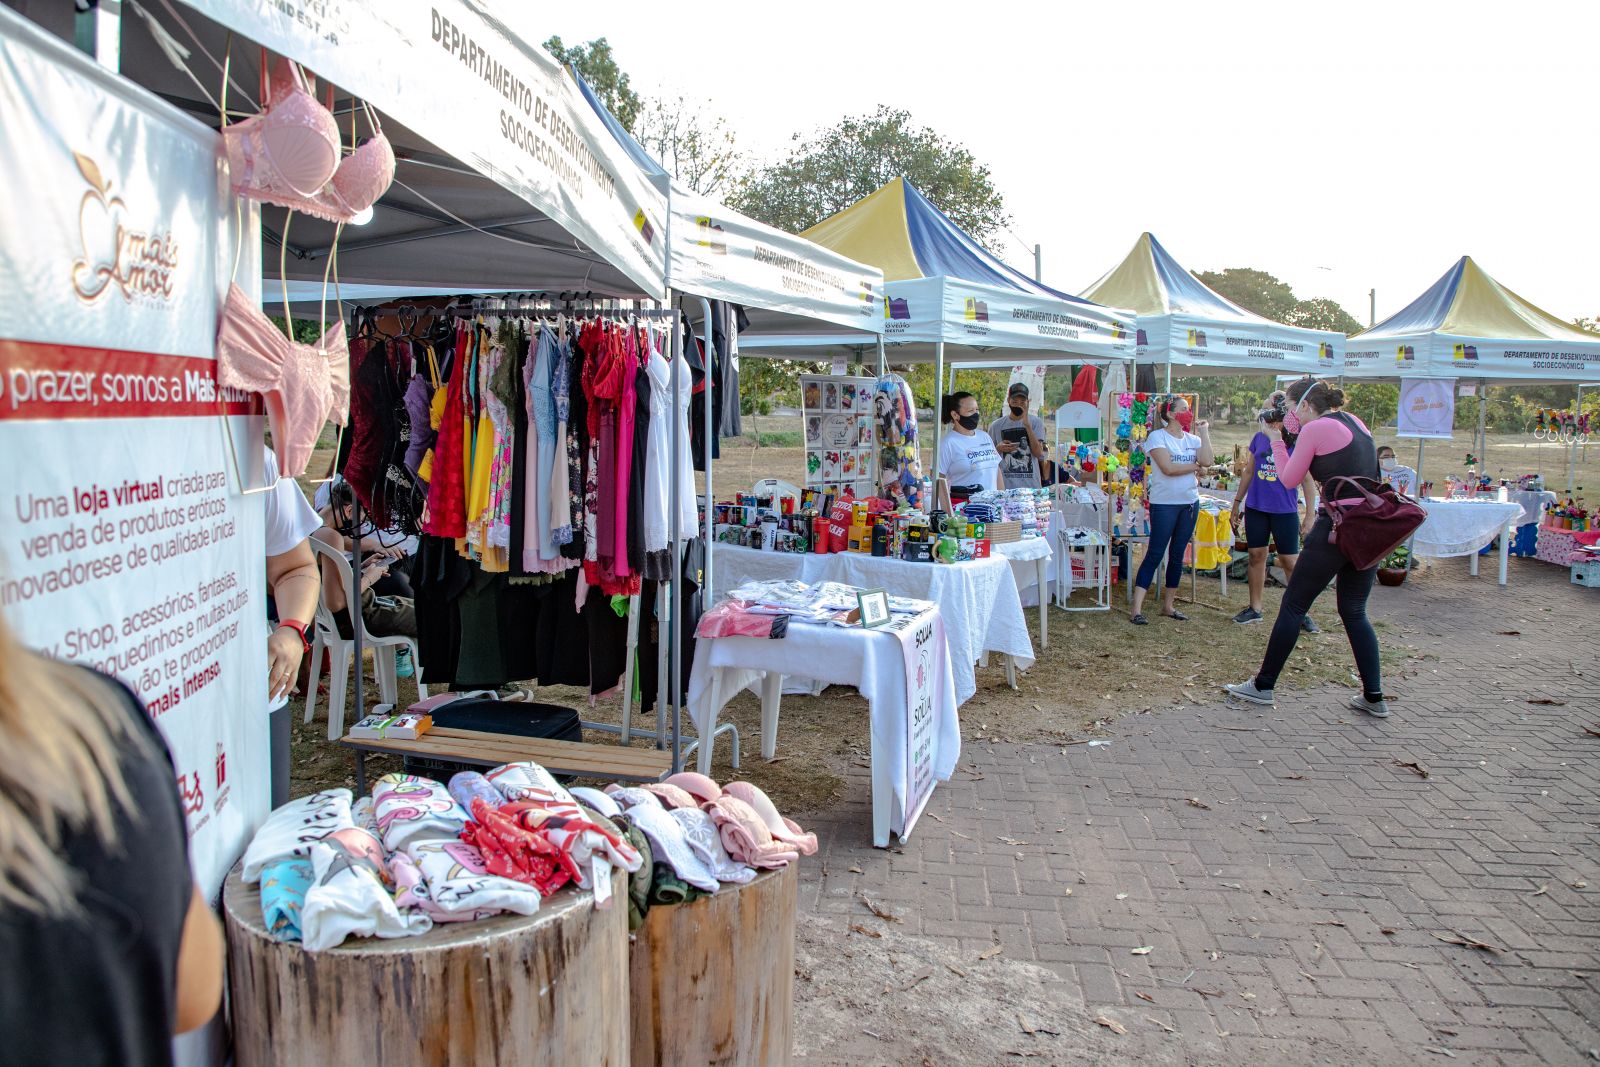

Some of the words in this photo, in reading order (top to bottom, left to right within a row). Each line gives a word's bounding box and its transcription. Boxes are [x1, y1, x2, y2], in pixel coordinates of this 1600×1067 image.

[431, 6, 532, 116] DEPARTAMENTO
[535, 96, 548, 130] DE
[550, 109, 615, 200] DESENVOLVIMENTO
[754, 245, 796, 273] DEPARTAMENTO
[797, 260, 805, 276] DE
[1013, 308, 1052, 323] DEPARTAMENTO
[1053, 314, 1060, 324] DE
[1060, 315, 1099, 331] DESENVOLVIMENTO
[1226, 337, 1260, 347] DEPARTAMENTO
[1260, 340, 1267, 348] DE
[1267, 340, 1304, 353] DESENVOLVIMENTO
[1503, 350, 1550, 360] DEPARTAMENTO
[1551, 352, 1560, 360] DE
[10, 366, 99, 411] prazer,
[102, 377, 166, 403] somos
[171, 376, 182, 402] a
[184, 370, 216, 403] Mais
[15, 492, 69, 525] Uma
[73, 484, 109, 516] loja
[113, 474, 164, 509] virtual
[167, 471, 204, 498] criada
[205, 470, 226, 493] para
[21, 522, 87, 560] venda
[91, 521, 115, 545] de
[119, 501, 185, 544] produtos
[187, 496, 226, 523] eróticos
[126, 545, 148, 568] de
[150, 522, 210, 565] qualidade
[211, 516, 236, 544] única!
[64, 622, 118, 660] Shop,
[121, 591, 197, 639] acessórios,
[198, 571, 238, 602] fantasias,
[92, 625, 184, 678] nquedinhos
[186, 622, 195, 640] e
[196, 600, 227, 633] muitas
[227, 588, 249, 617] outras
[132, 668, 161, 698] vão
[164, 661, 178, 681] te
[180, 620, 240, 677] proporcionar
[147, 689, 180, 719] mais
[183, 659, 222, 699] intenso.
